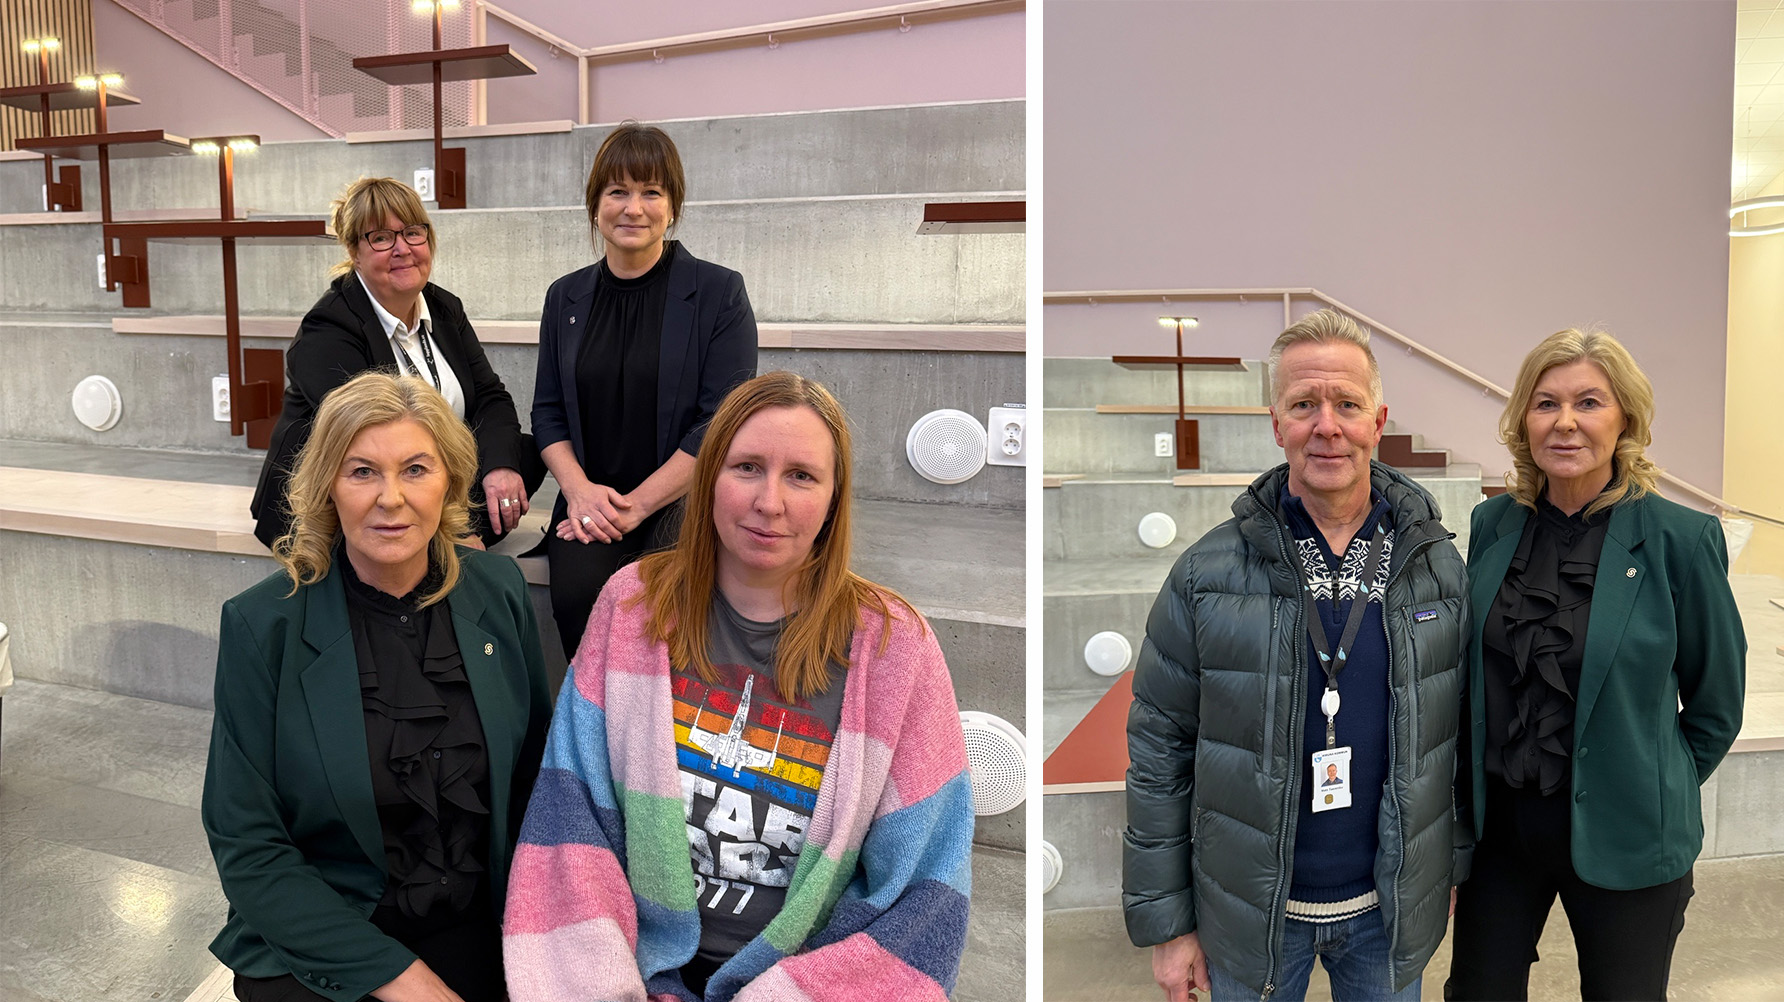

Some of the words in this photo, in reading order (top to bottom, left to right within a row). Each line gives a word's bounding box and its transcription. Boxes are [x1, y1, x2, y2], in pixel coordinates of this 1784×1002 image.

[679, 769, 811, 855] TAR
[686, 822, 801, 887] AR
[694, 872, 754, 914] 977
